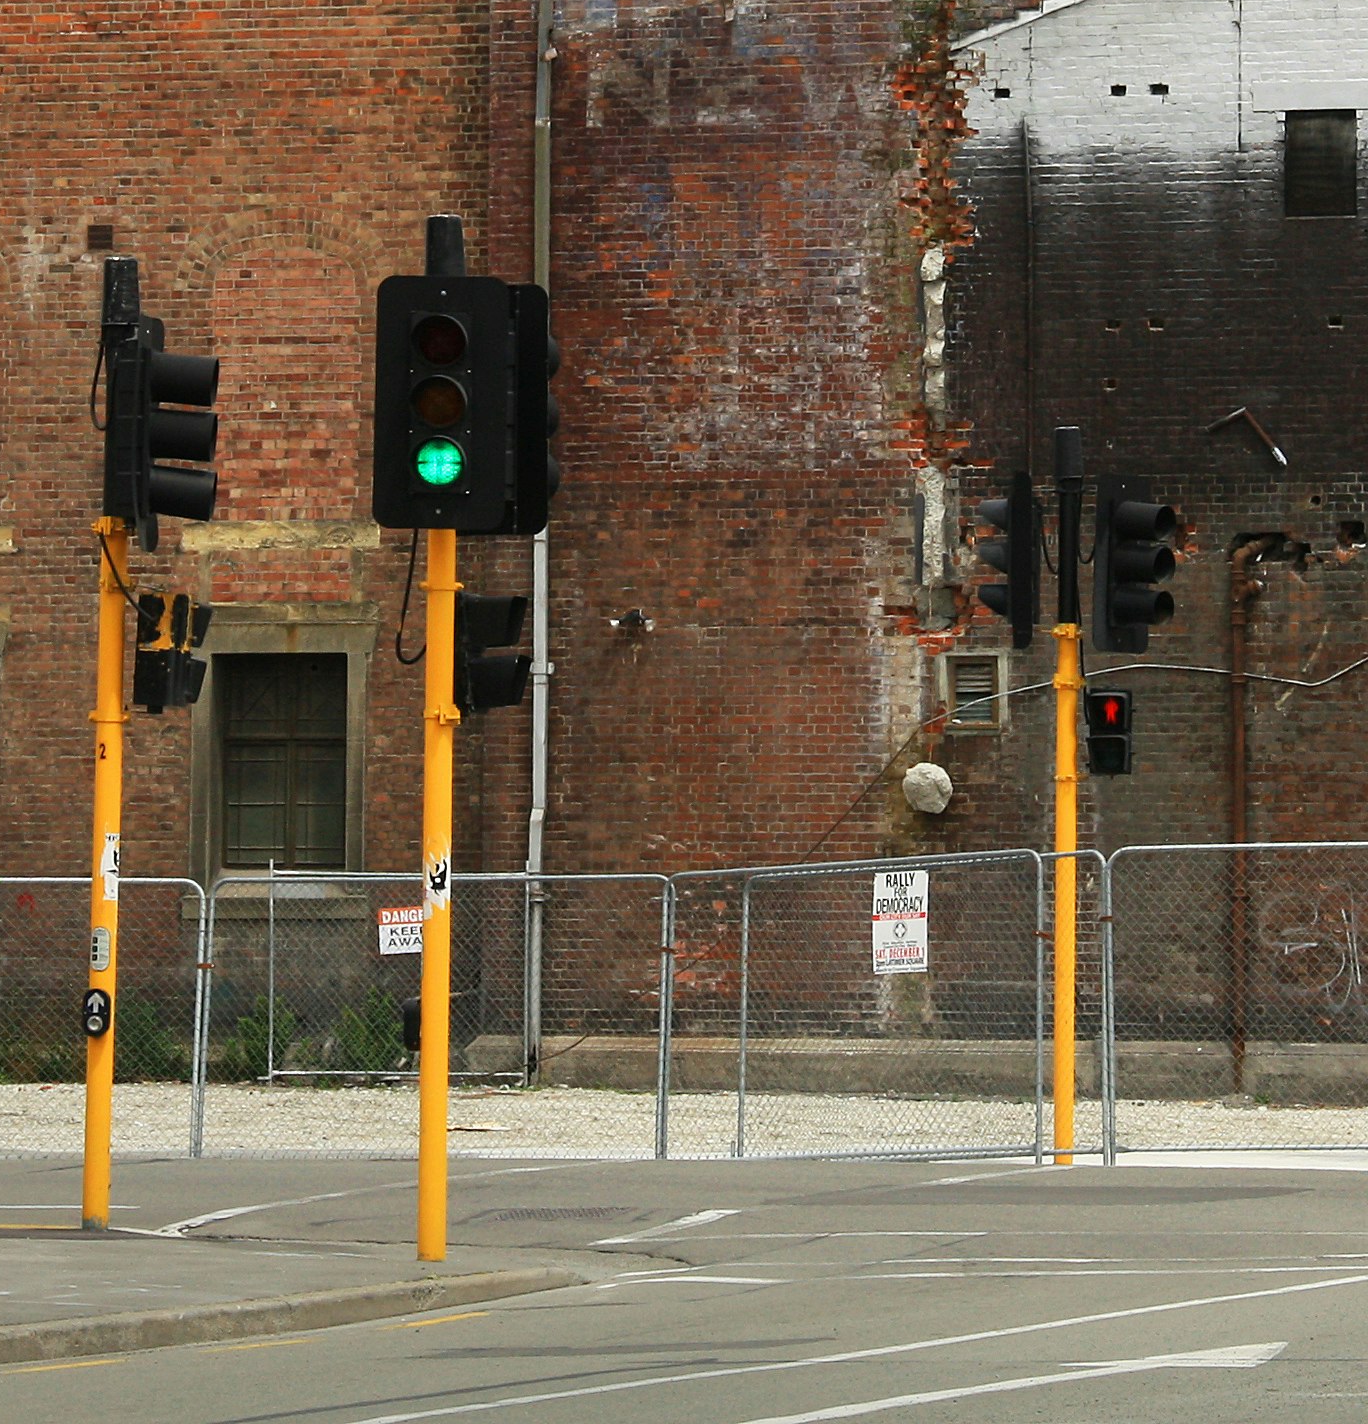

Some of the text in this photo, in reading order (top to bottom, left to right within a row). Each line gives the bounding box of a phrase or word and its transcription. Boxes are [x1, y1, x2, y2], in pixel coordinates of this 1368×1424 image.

[99, 743, 106, 759] 2
[886, 872, 915, 888] RALLY
[894, 887, 907, 897] FOR
[876, 896, 923, 914] DEMOCRACY
[382, 909, 423, 923] DANGE
[390, 926, 423, 936] KEE
[388, 937, 422, 946] AWA
